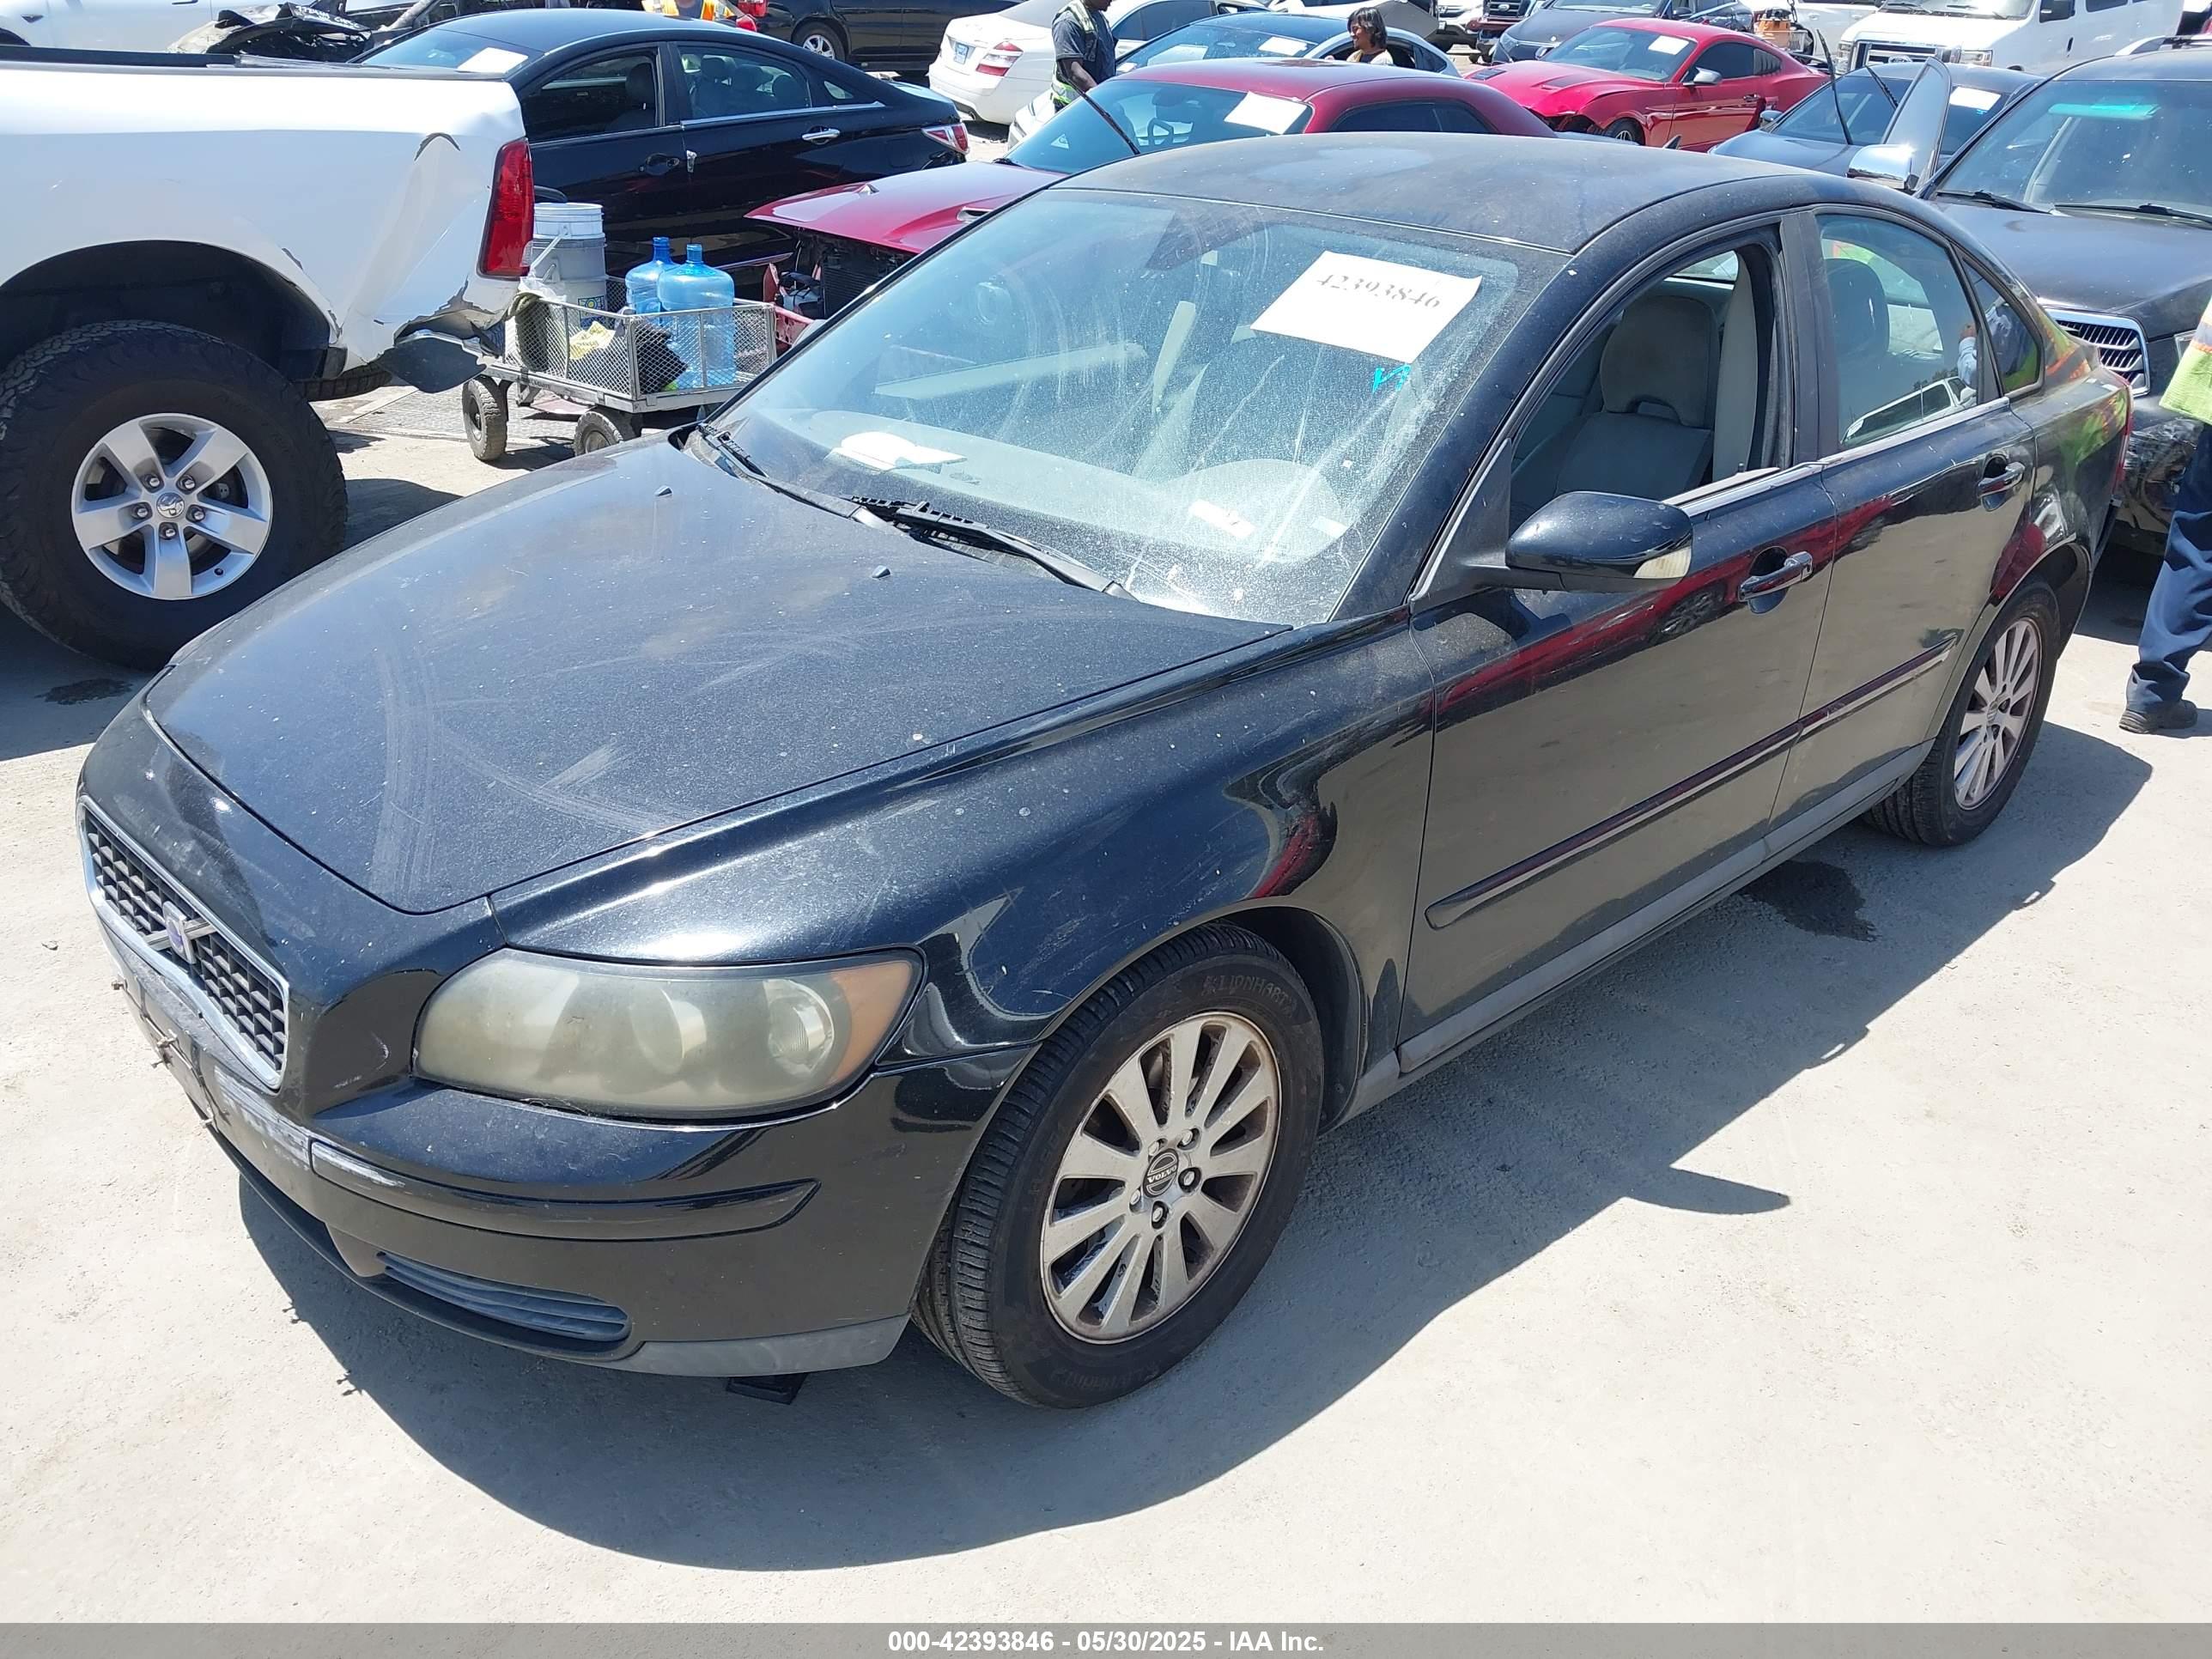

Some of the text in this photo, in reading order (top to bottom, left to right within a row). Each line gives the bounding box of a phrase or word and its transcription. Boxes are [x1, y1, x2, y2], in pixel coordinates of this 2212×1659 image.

[1316, 273, 1441, 308] 42393846
[1218, 975, 1290, 1006] LIONHART
[1146, 1164, 1177, 1183] VOLVO
